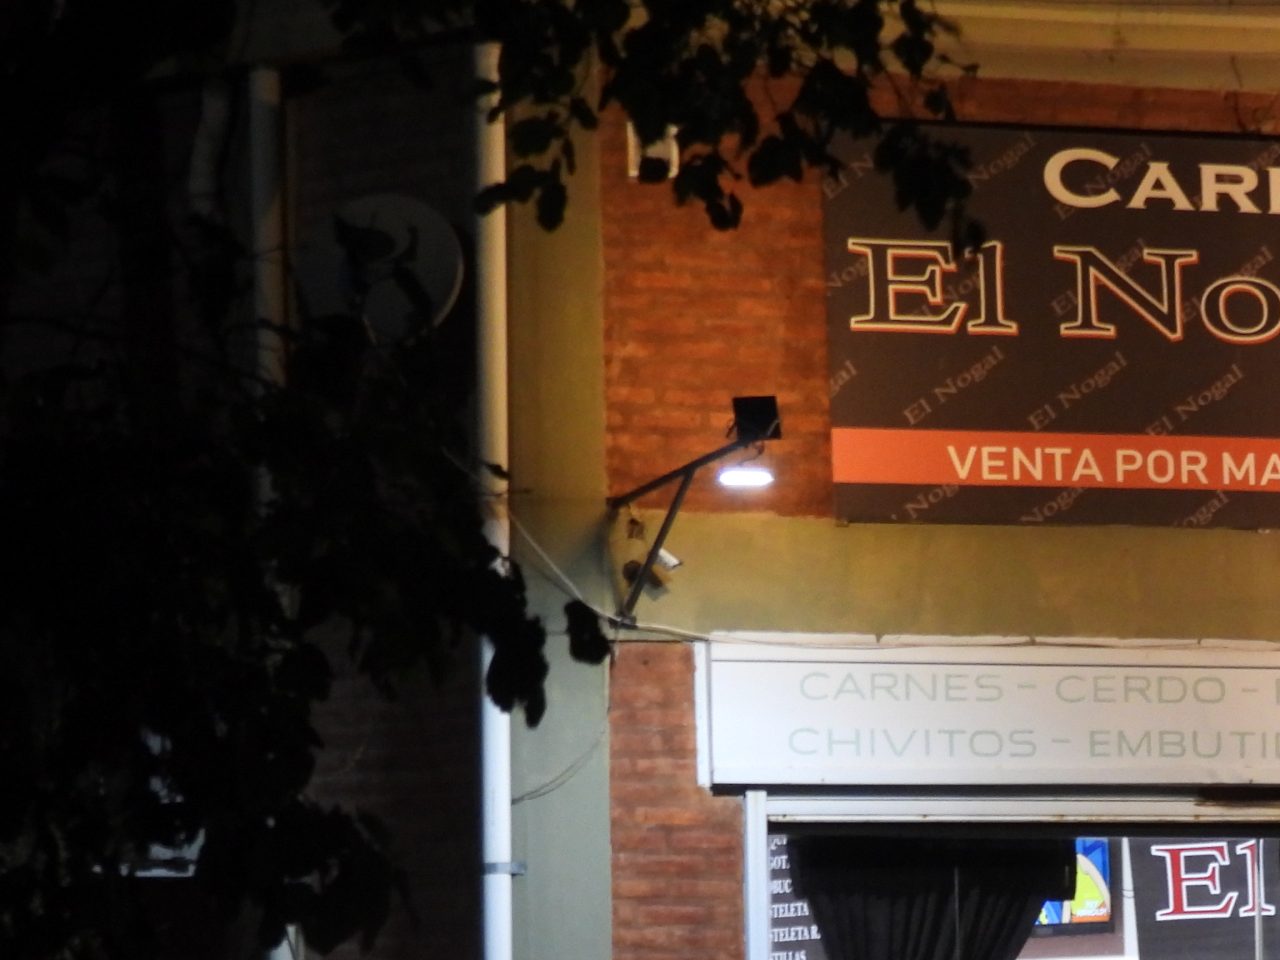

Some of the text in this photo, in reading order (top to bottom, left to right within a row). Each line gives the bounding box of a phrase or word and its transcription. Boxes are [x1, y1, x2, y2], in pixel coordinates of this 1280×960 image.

[847, 237, 1019, 336] El
[903, 345, 1005, 425] El Nogal
[1027, 350, 1128, 431] El Nogal
[1174, 363, 1245, 421] Nogal
[947, 445, 1104, 482] VENTA
[1116, 449, 1209, 484] POR
[799, 672, 1003, 703] CARNES
[1055, 675, 1227, 704] CERDO
[787, 727, 1037, 757] CHIVITOS
[1150, 839, 1276, 921] El
